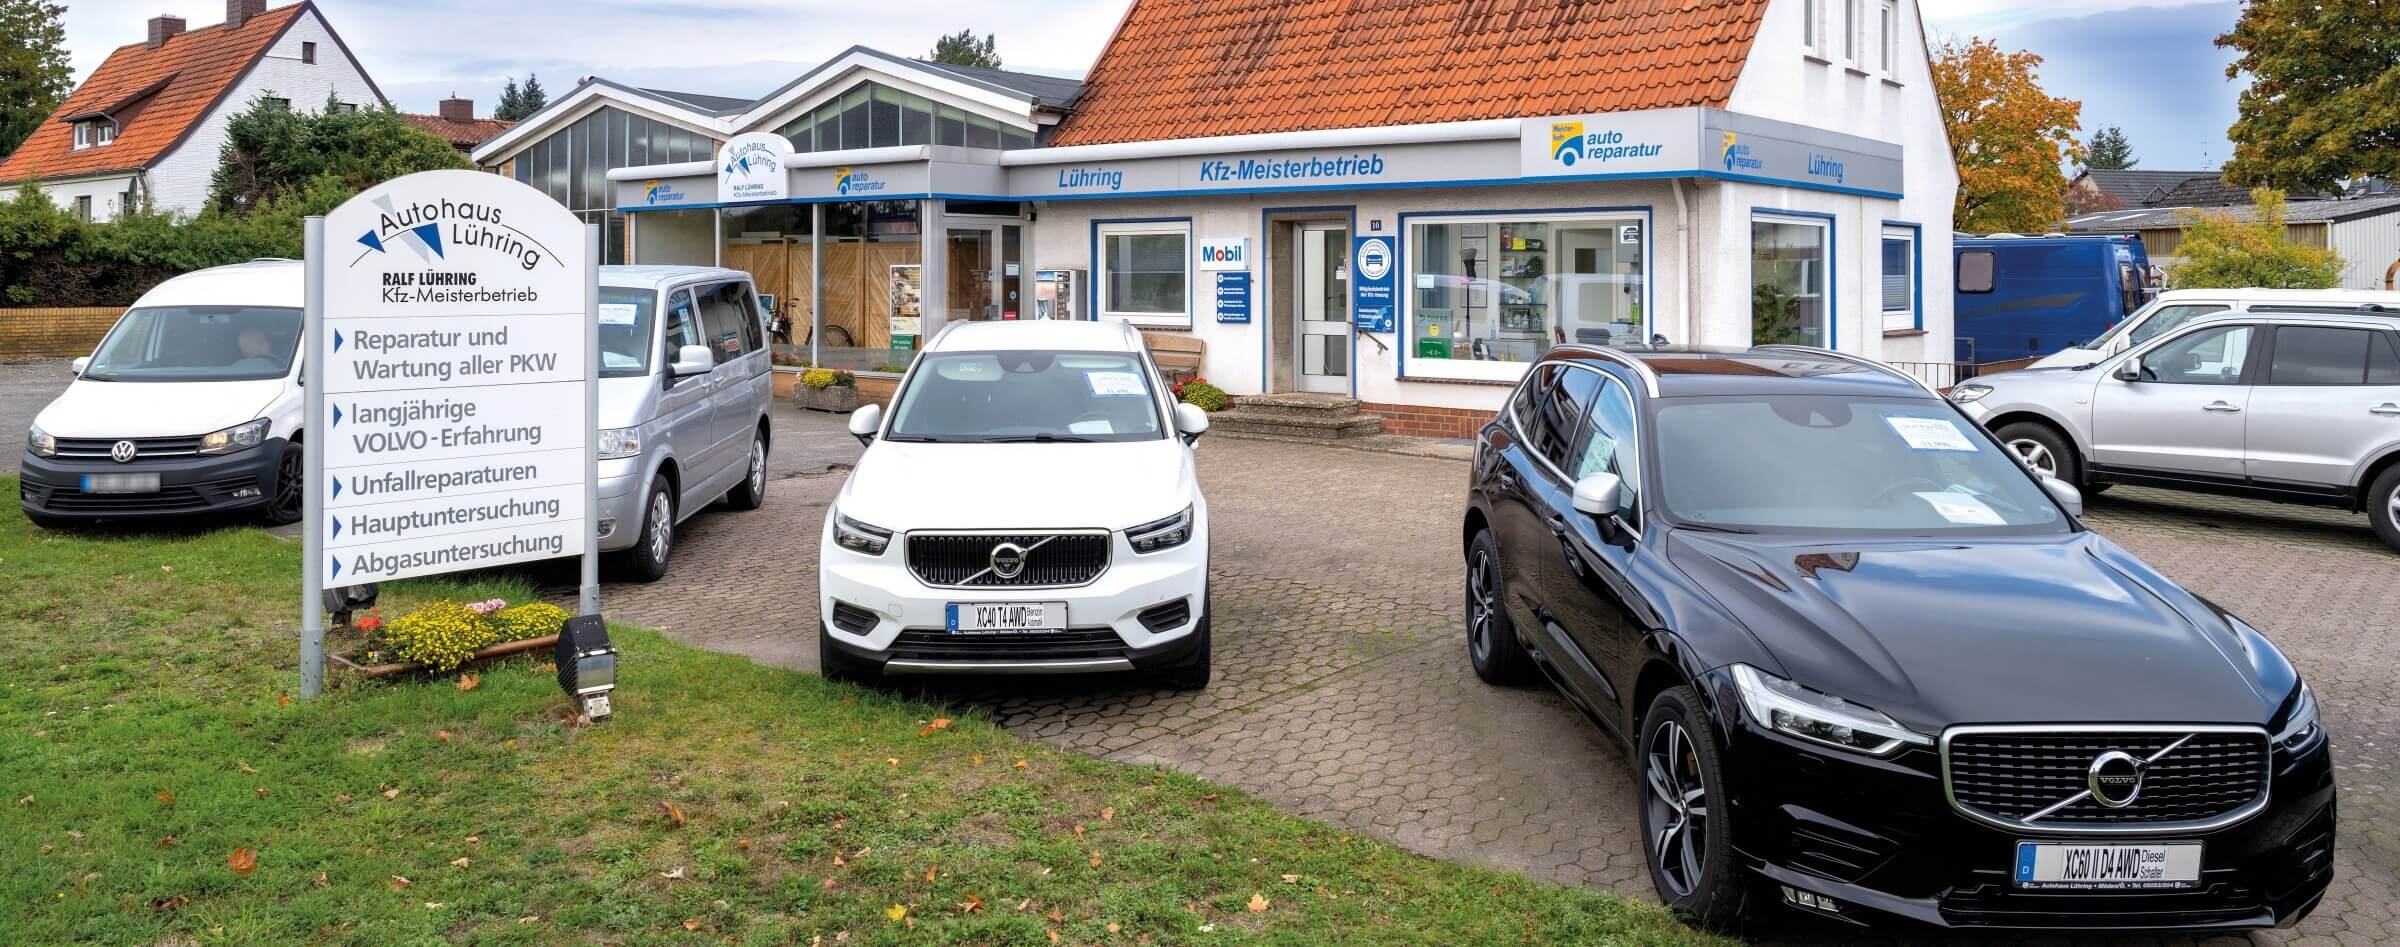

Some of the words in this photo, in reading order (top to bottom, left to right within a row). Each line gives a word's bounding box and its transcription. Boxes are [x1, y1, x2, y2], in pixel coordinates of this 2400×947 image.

[1587, 130, 1623, 145] auto
[731, 140, 766, 166] Autohaus
[1587, 143, 1663, 162] reparatur
[1736, 144, 1750, 155] auto
[748, 153, 777, 173] Lühring
[1200, 153, 1385, 182] Kfz-Meisterbetrieb
[1736, 156, 1763, 170] reparatur
[1807, 152, 1844, 184] Lühring
[851, 172, 869, 181] auto
[852, 181, 885, 192] reparatur
[1058, 167, 1123, 190] Lühring
[658, 184, 672, 192] auto
[658, 192, 685, 201] reparatur
[380, 198, 502, 237] Autohaus
[452, 223, 541, 271] Lühring
[1202, 245, 1242, 262] Mobil
[382, 272, 415, 286] RALF
[419, 269, 477, 286] LÜHRING
[382, 286, 538, 303] Kfz-Meisterbetrieb
[354, 329, 462, 354] Reparatur
[468, 326, 508, 346] und
[353, 359, 452, 381] Wartung
[459, 355, 503, 375] aller
[510, 353, 557, 373] PKW
[352, 398, 476, 427] langjährige
[352, 464, 537, 495] Unfallreparaturen
[351, 498, 560, 536] Hauptuntersuchung
[351, 534, 563, 576] Abgasuntersuchung
[976, 606, 997, 628] XC40
[998, 606, 1007, 627] T4
[1009, 606, 1027, 627] AWD
[2022, 865, 2030, 874] D
[2063, 848, 2091, 880] XC60
[2100, 848, 2115, 879] D4
[2115, 848, 2142, 879] AWD
[2141, 849, 2166, 863] Diesel
[2140, 867, 2164, 880] Schalter
[2070, 882, 2093, 890] Lühring
